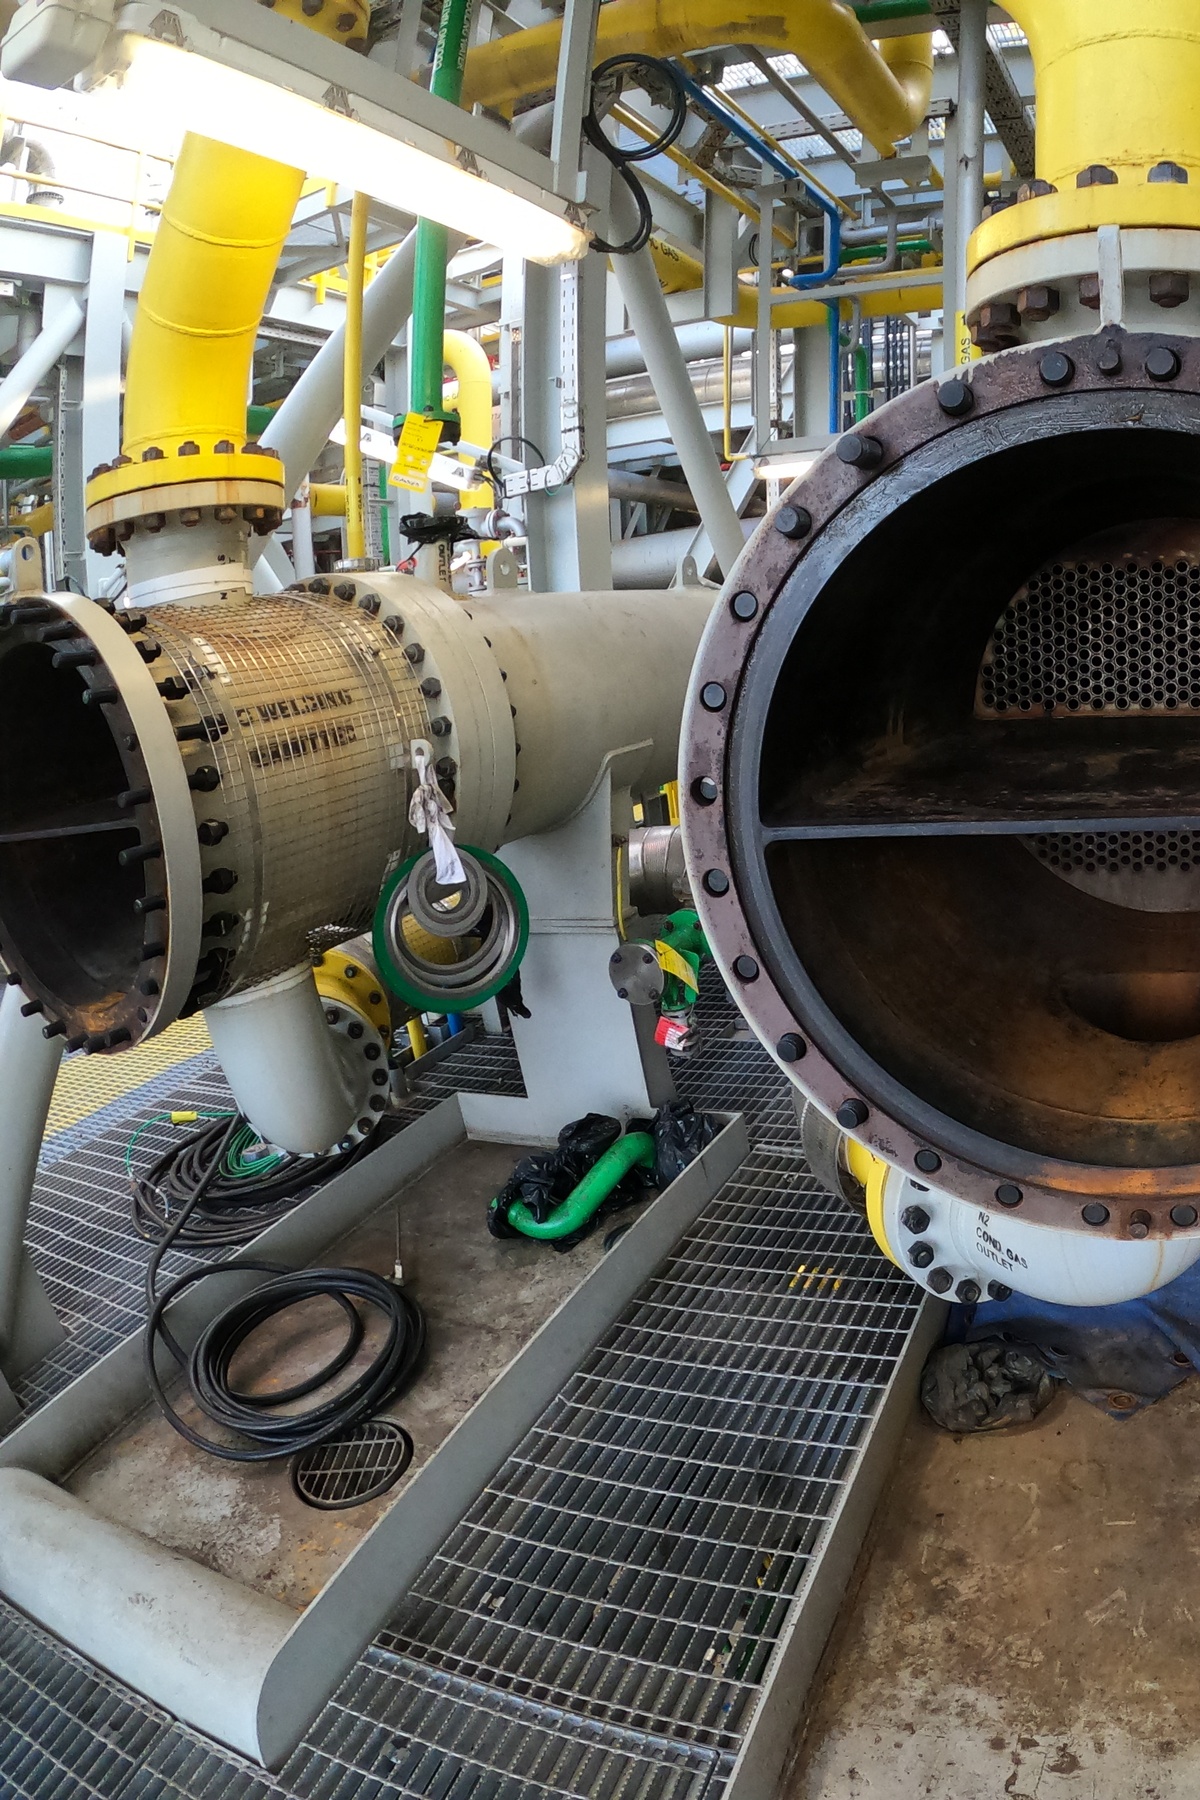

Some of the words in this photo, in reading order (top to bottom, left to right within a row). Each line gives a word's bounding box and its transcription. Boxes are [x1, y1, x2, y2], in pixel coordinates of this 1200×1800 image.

[961, 337, 970, 365] GAS
[438, 543, 446, 582] OUTLET
[978, 1211, 990, 1227] N2
[976, 1242, 1014, 1272] OUTLET
[1006, 1248, 1028, 1269] GAS
